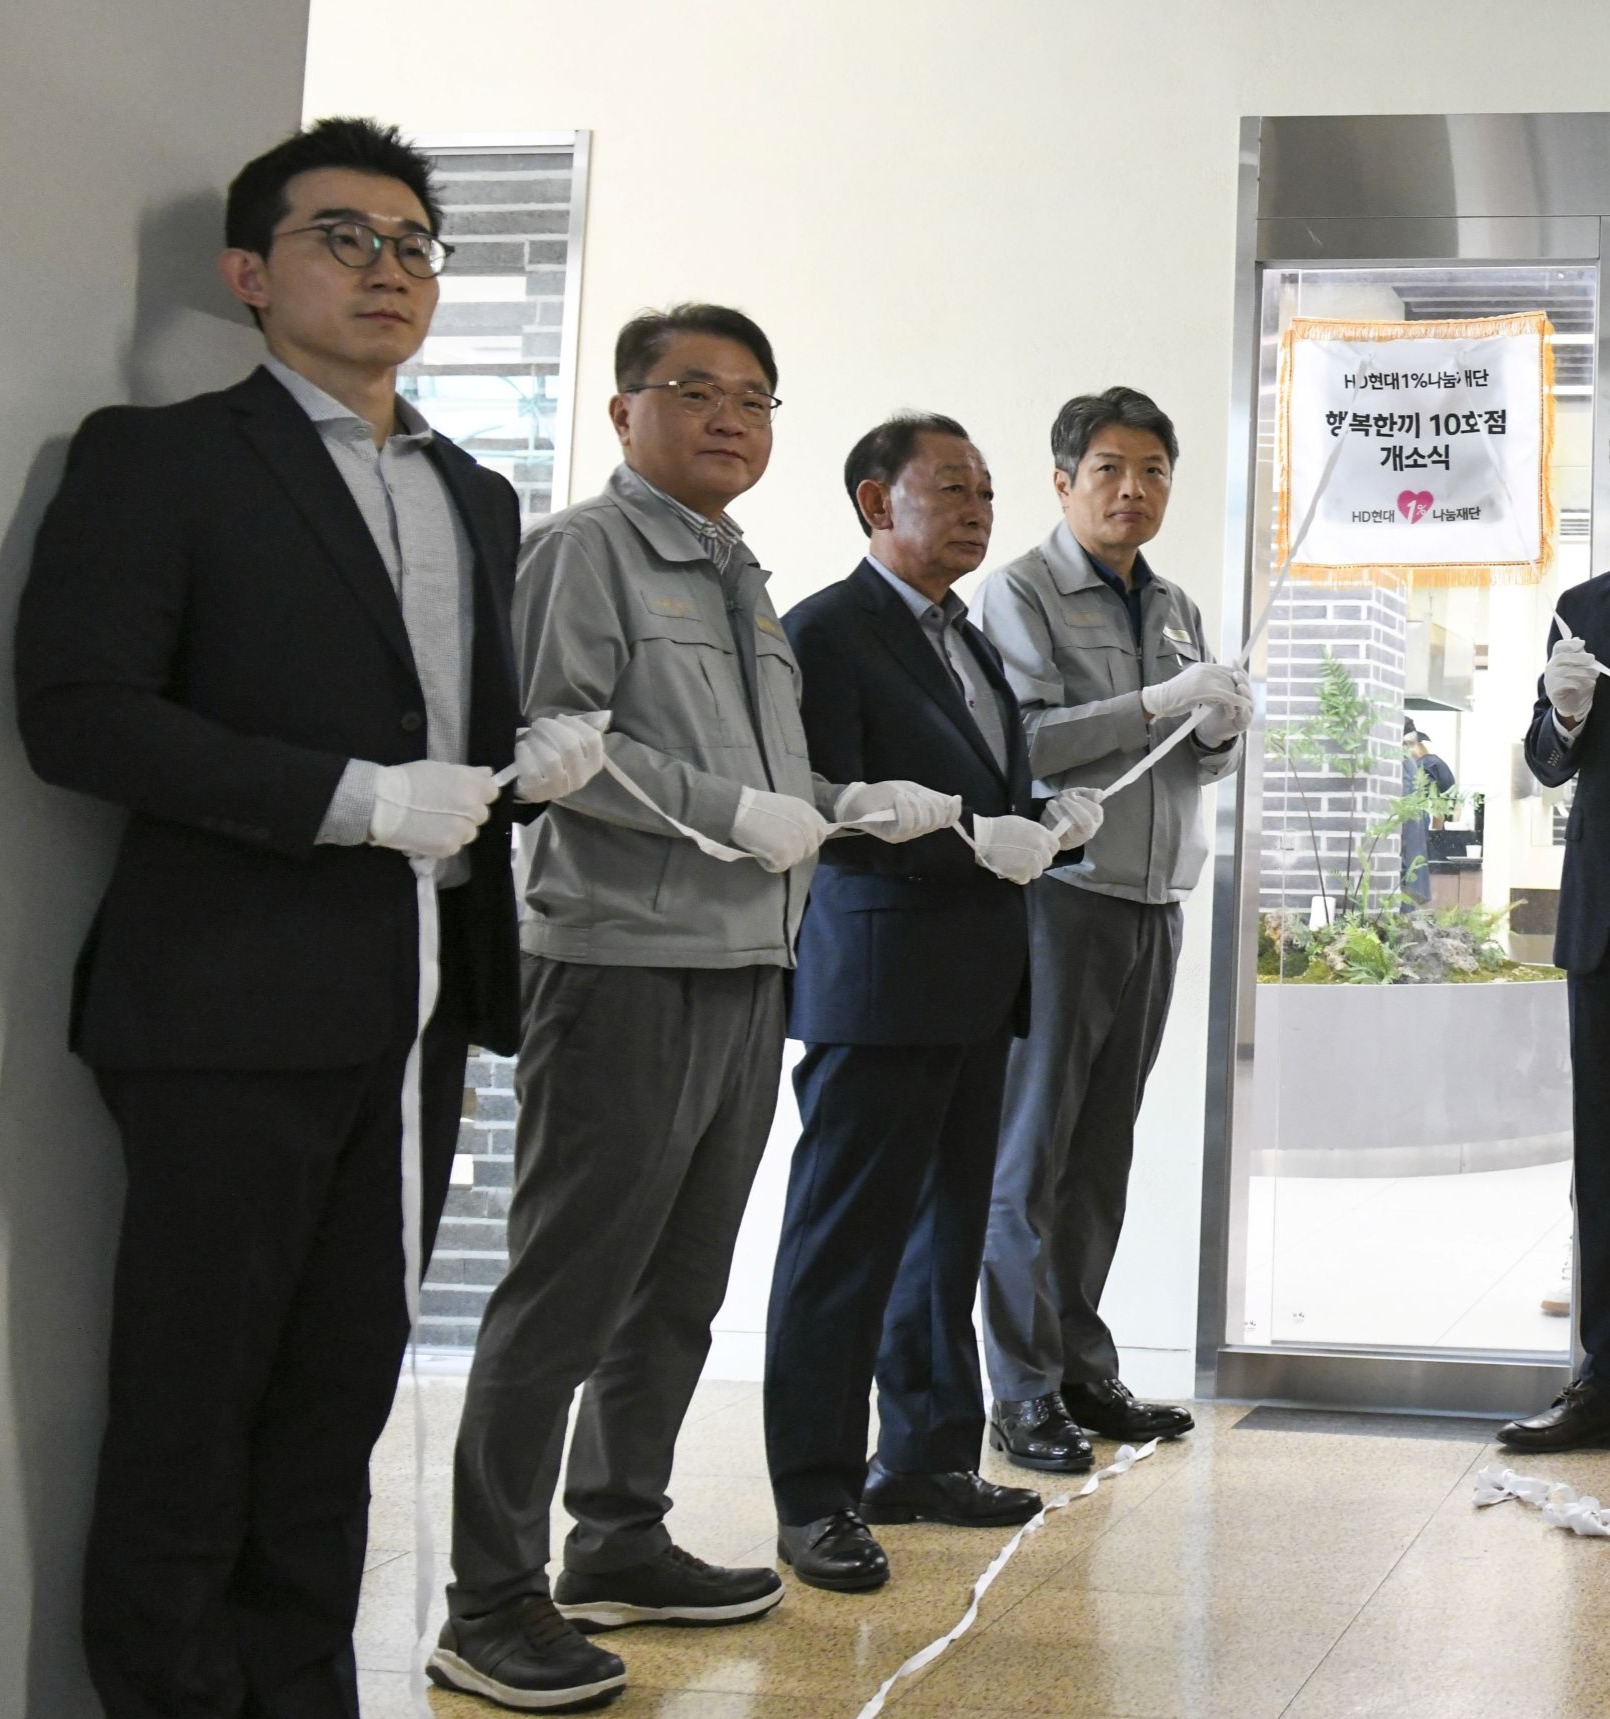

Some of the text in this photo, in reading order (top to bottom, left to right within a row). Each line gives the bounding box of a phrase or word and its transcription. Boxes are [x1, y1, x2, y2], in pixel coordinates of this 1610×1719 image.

[1326, 409, 1507, 439] 행복한끼 10호점
[1381, 444, 1450, 472] 개소식
[1352, 499, 1482, 525] HD현대 1% 나눔재단
